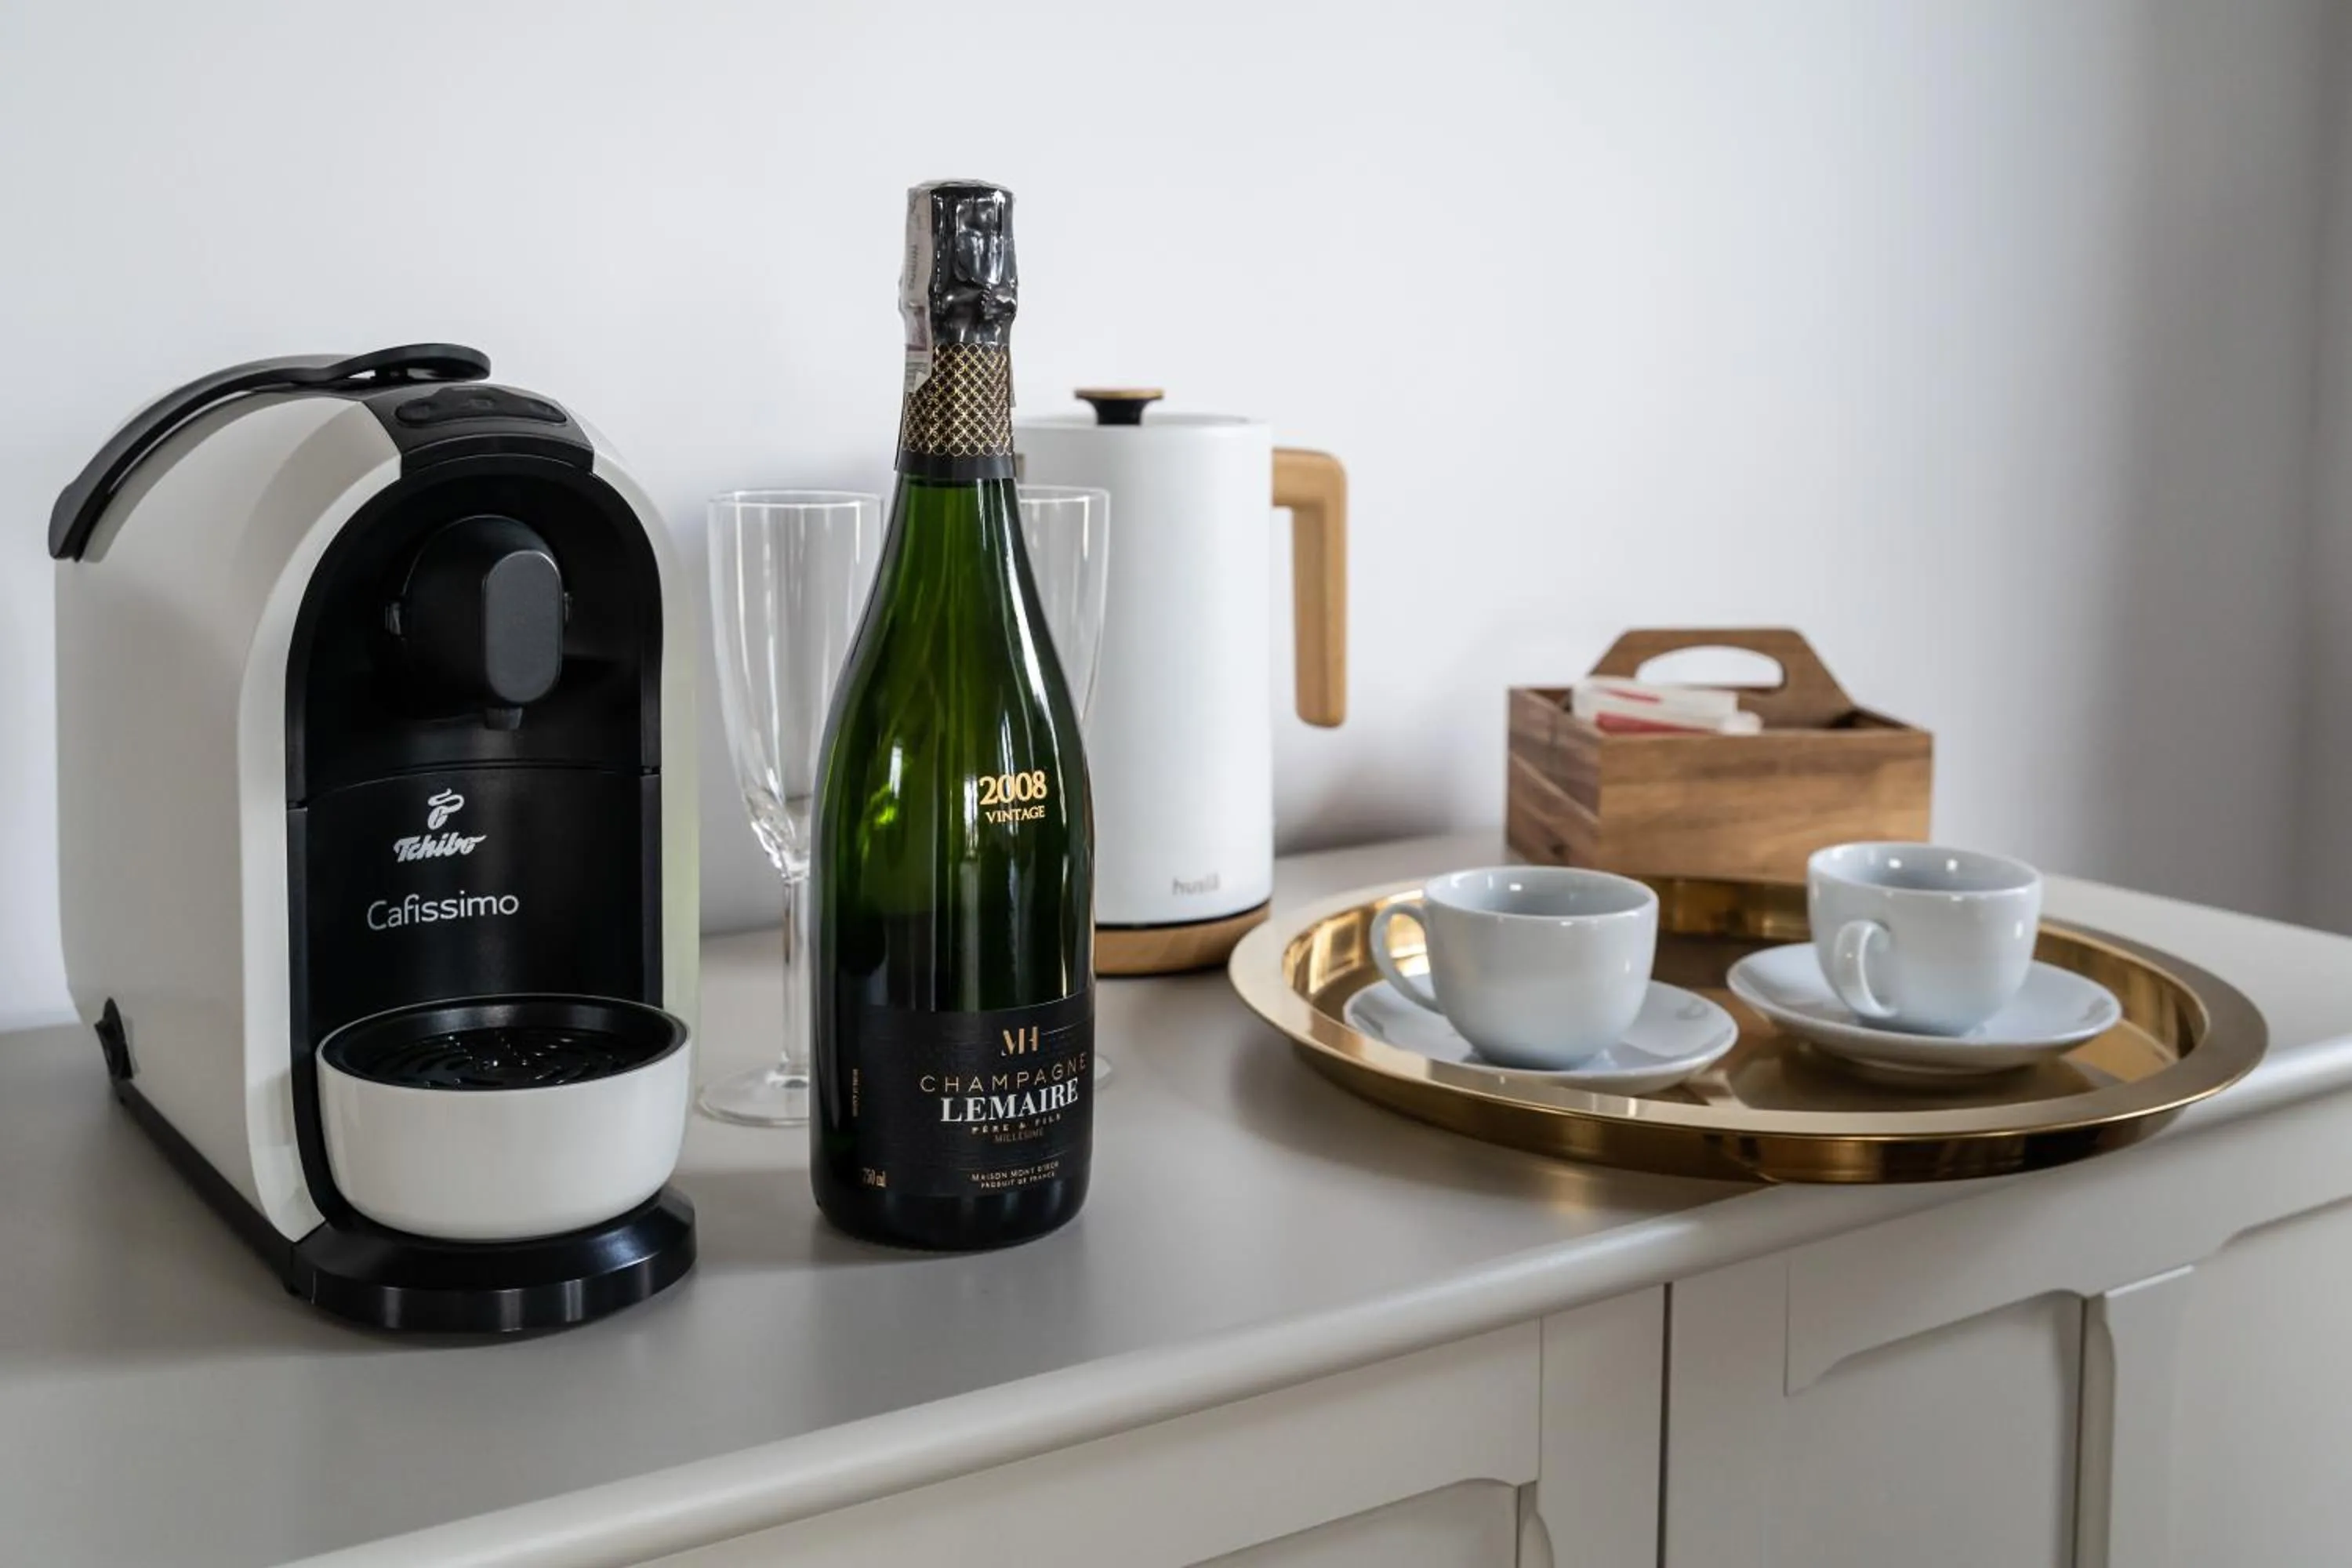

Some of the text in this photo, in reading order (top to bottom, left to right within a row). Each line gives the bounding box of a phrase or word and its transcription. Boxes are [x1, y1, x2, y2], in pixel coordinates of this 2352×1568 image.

[978, 770, 1047, 805] 2008
[985, 805, 1046, 824] VINTAGE
[394, 832, 487, 862] Tchibo
[367, 890, 519, 931] Cafissimo
[920, 1051, 1087, 1093] CHAMPAGNE
[941, 1077, 1079, 1122] LEMAIRE
